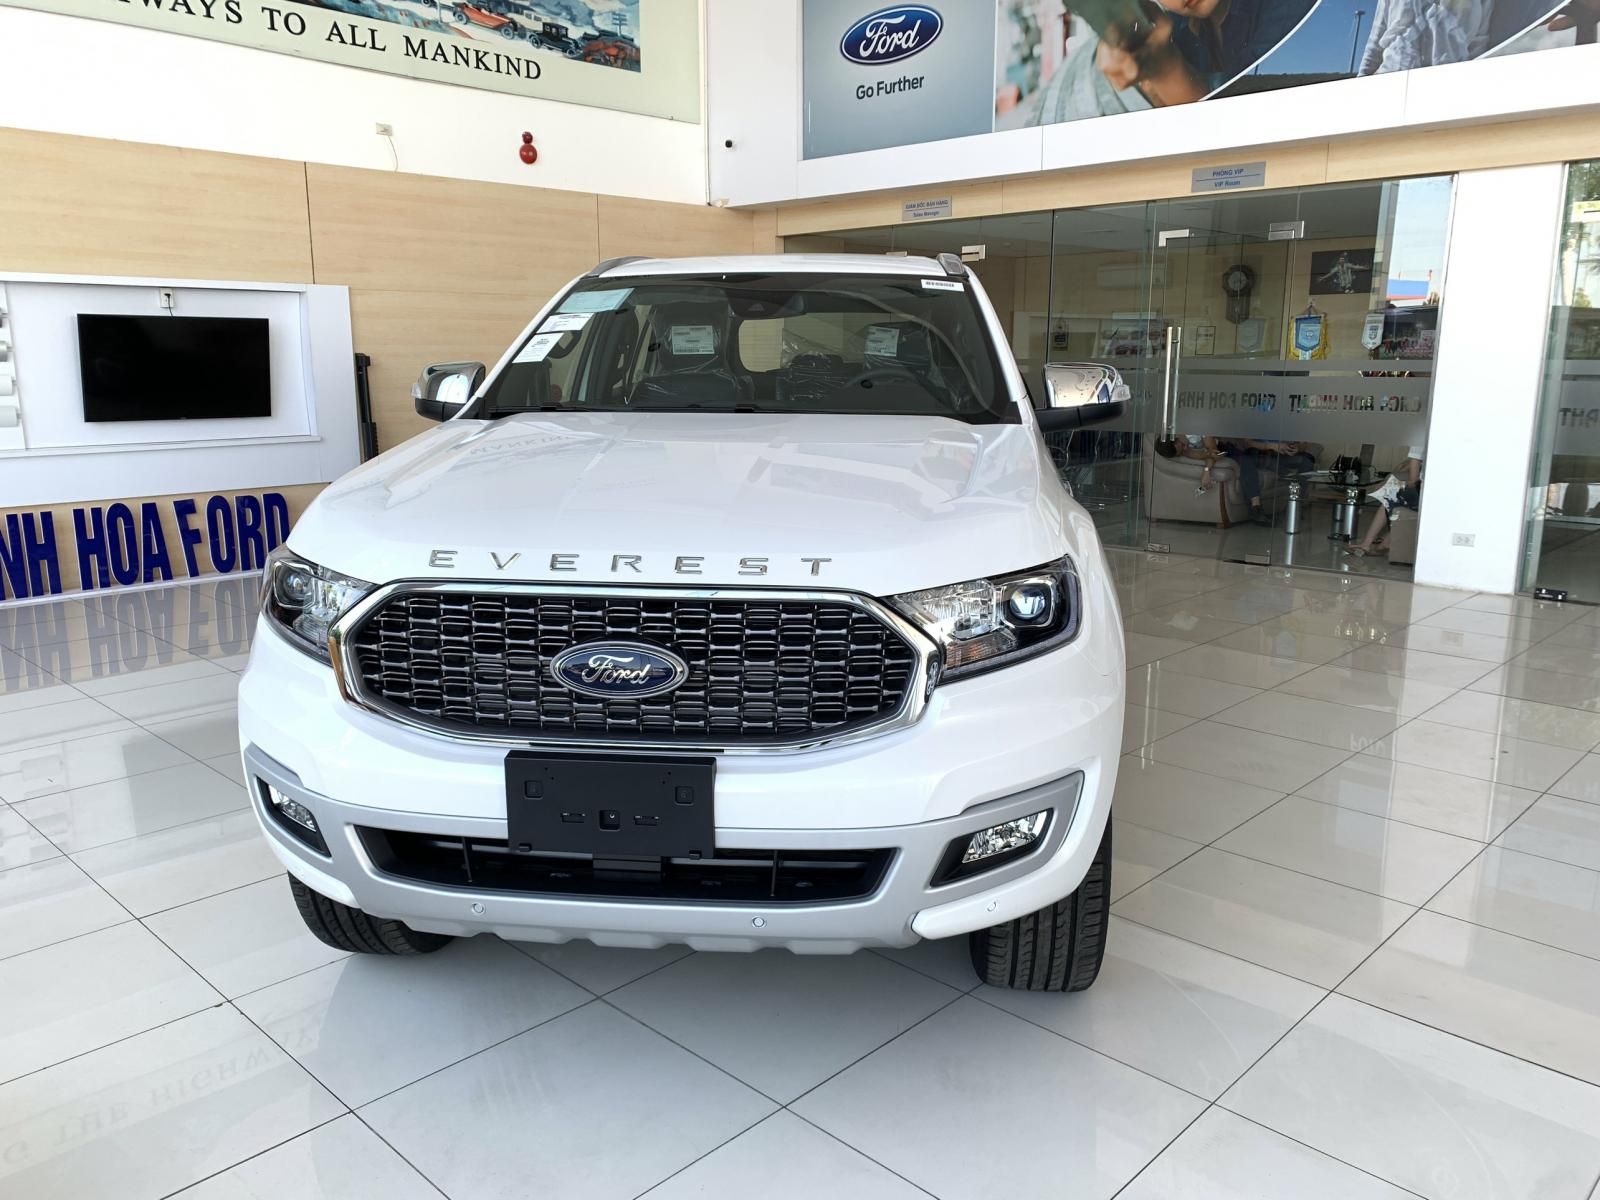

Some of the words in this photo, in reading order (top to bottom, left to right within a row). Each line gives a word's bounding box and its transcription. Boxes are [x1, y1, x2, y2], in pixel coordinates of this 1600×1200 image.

[261, 6, 306, 36] TO
[325, 20, 387, 52] ALL
[402, 34, 542, 80] MANKIND
[859, 14, 921, 57] Ford
[856, 85, 874, 100] Go
[876, 75, 925, 96] Further
[73, 502, 173, 591] HOA
[173, 492, 290, 578] FORD
[428, 549, 832, 577] EVEREST
[581, 654, 652, 685] Ford
